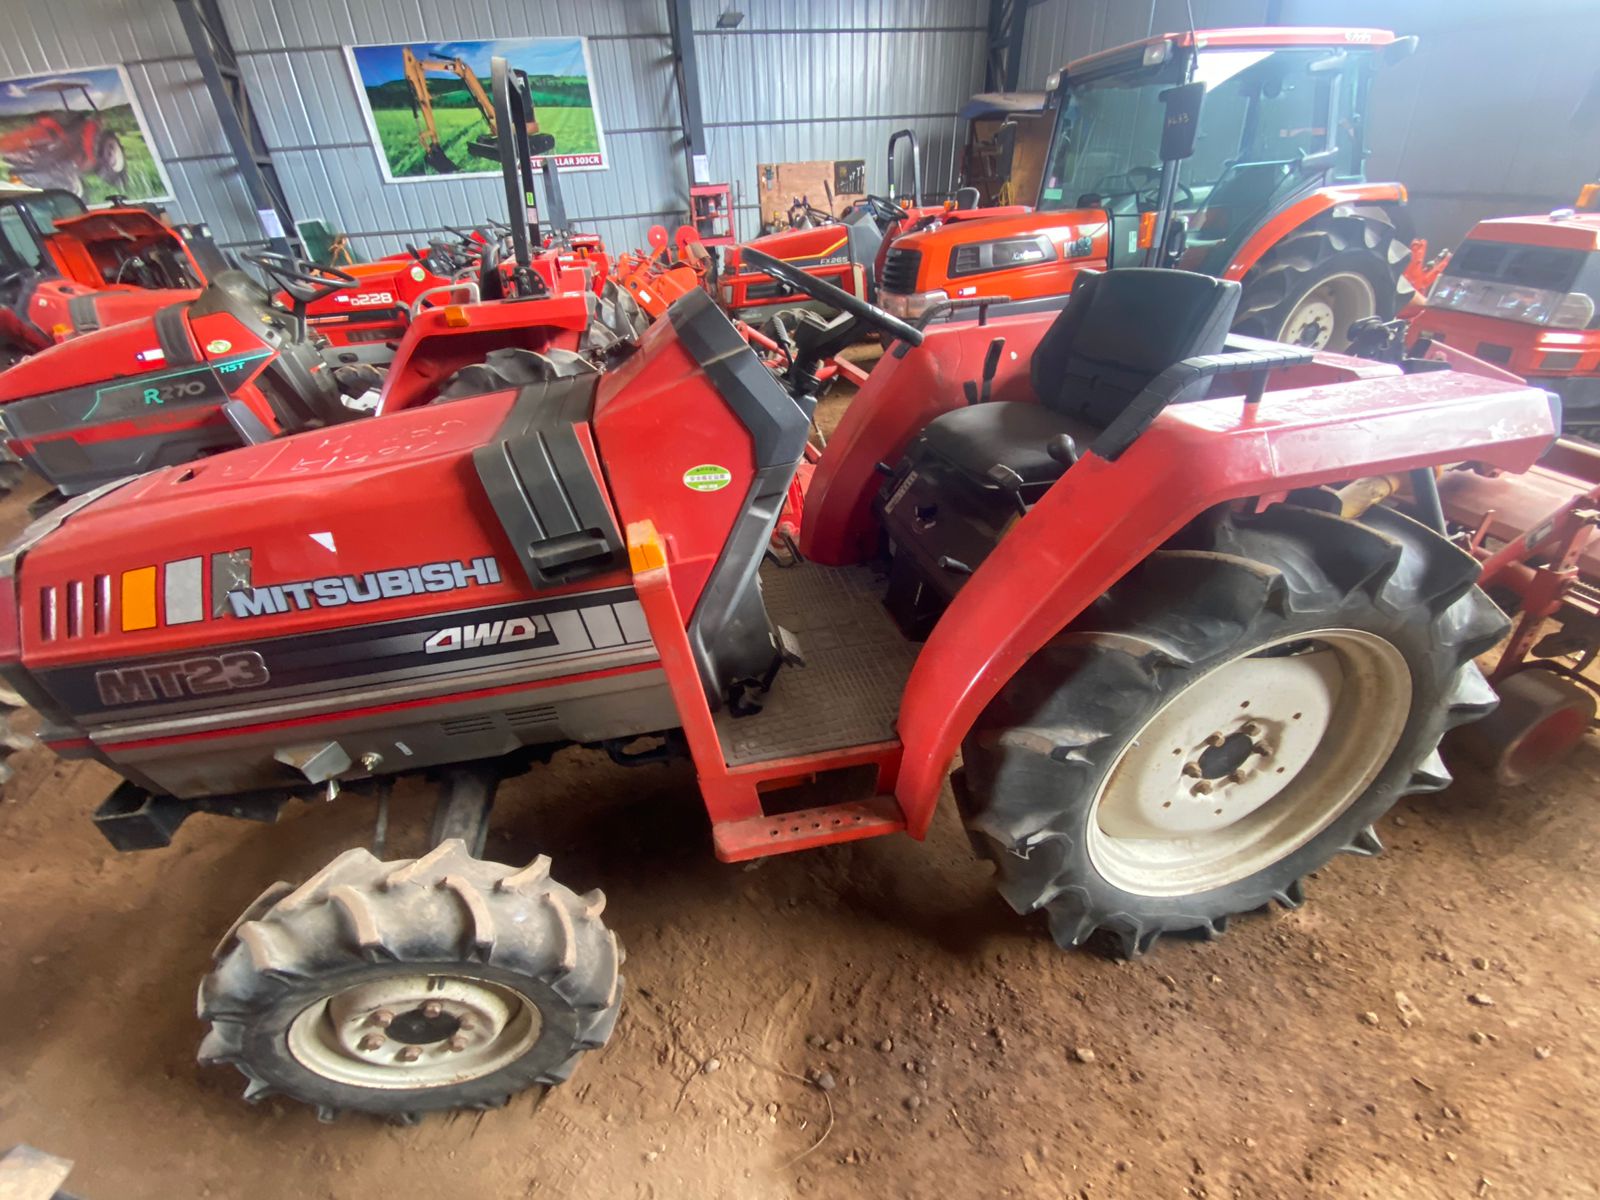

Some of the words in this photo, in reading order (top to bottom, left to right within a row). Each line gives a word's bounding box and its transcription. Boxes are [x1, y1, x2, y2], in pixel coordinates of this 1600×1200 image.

[575, 156, 600, 166] 303CR
[350, 292, 393, 306] D228
[219, 361, 246, 374] HST
[143, 381, 206, 405] R270
[228, 556, 502, 619] MITSUBISHI
[424, 616, 538, 655] 4WD
[94, 649, 271, 706] MT23
